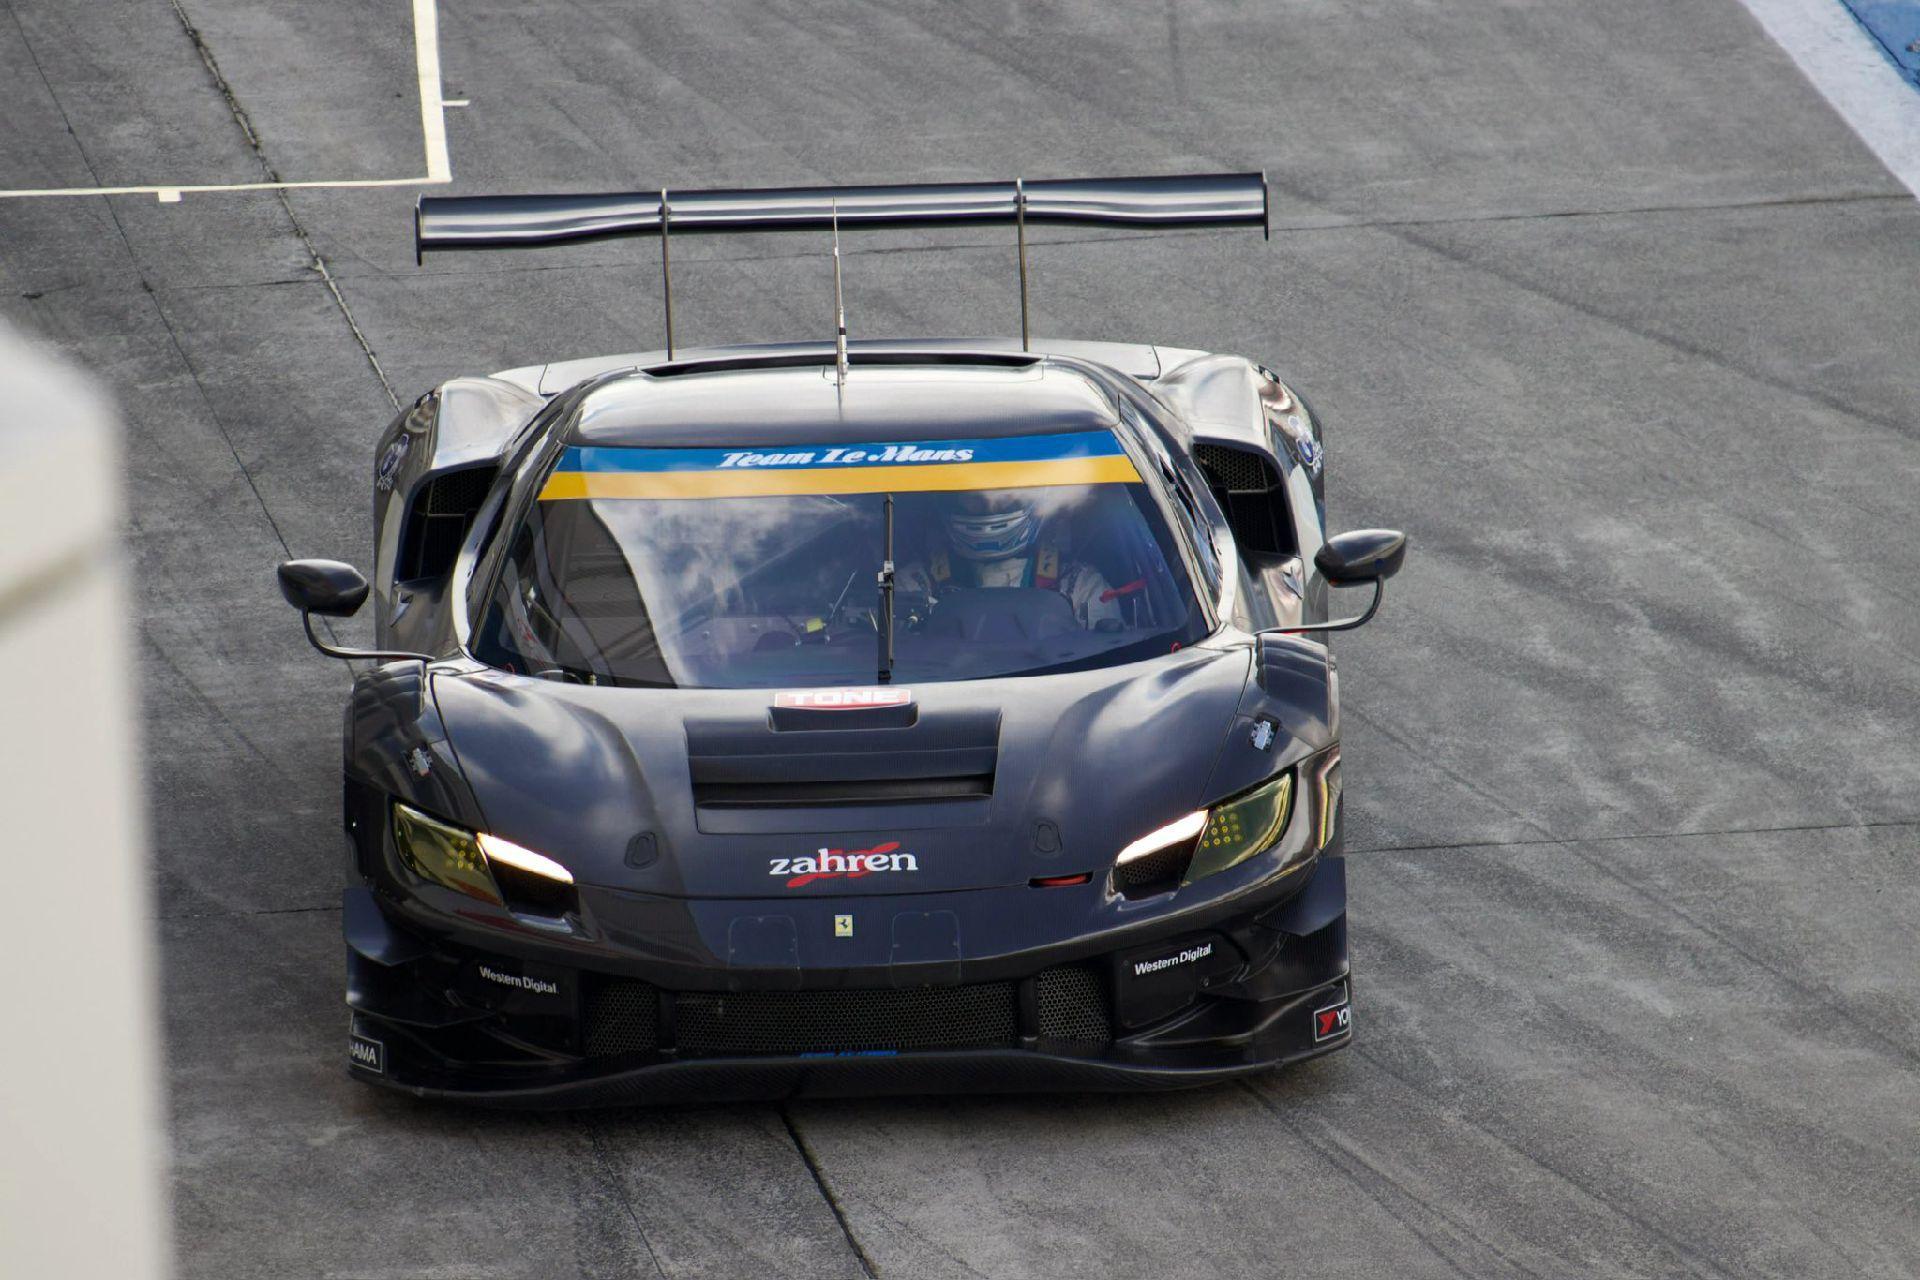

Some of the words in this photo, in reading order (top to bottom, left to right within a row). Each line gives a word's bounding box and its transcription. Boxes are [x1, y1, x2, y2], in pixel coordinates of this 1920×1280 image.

[716, 451, 816, 468] Team
[816, 448, 864, 464] Le
[868, 445, 974, 463] Mans
[787, 689, 899, 705] TONE
[769, 848, 919, 875] zahren
[1134, 956, 1179, 976] Western
[1180, 942, 1212, 963] Digital
[479, 965, 522, 988] Western
[522, 976, 558, 993] Digital
